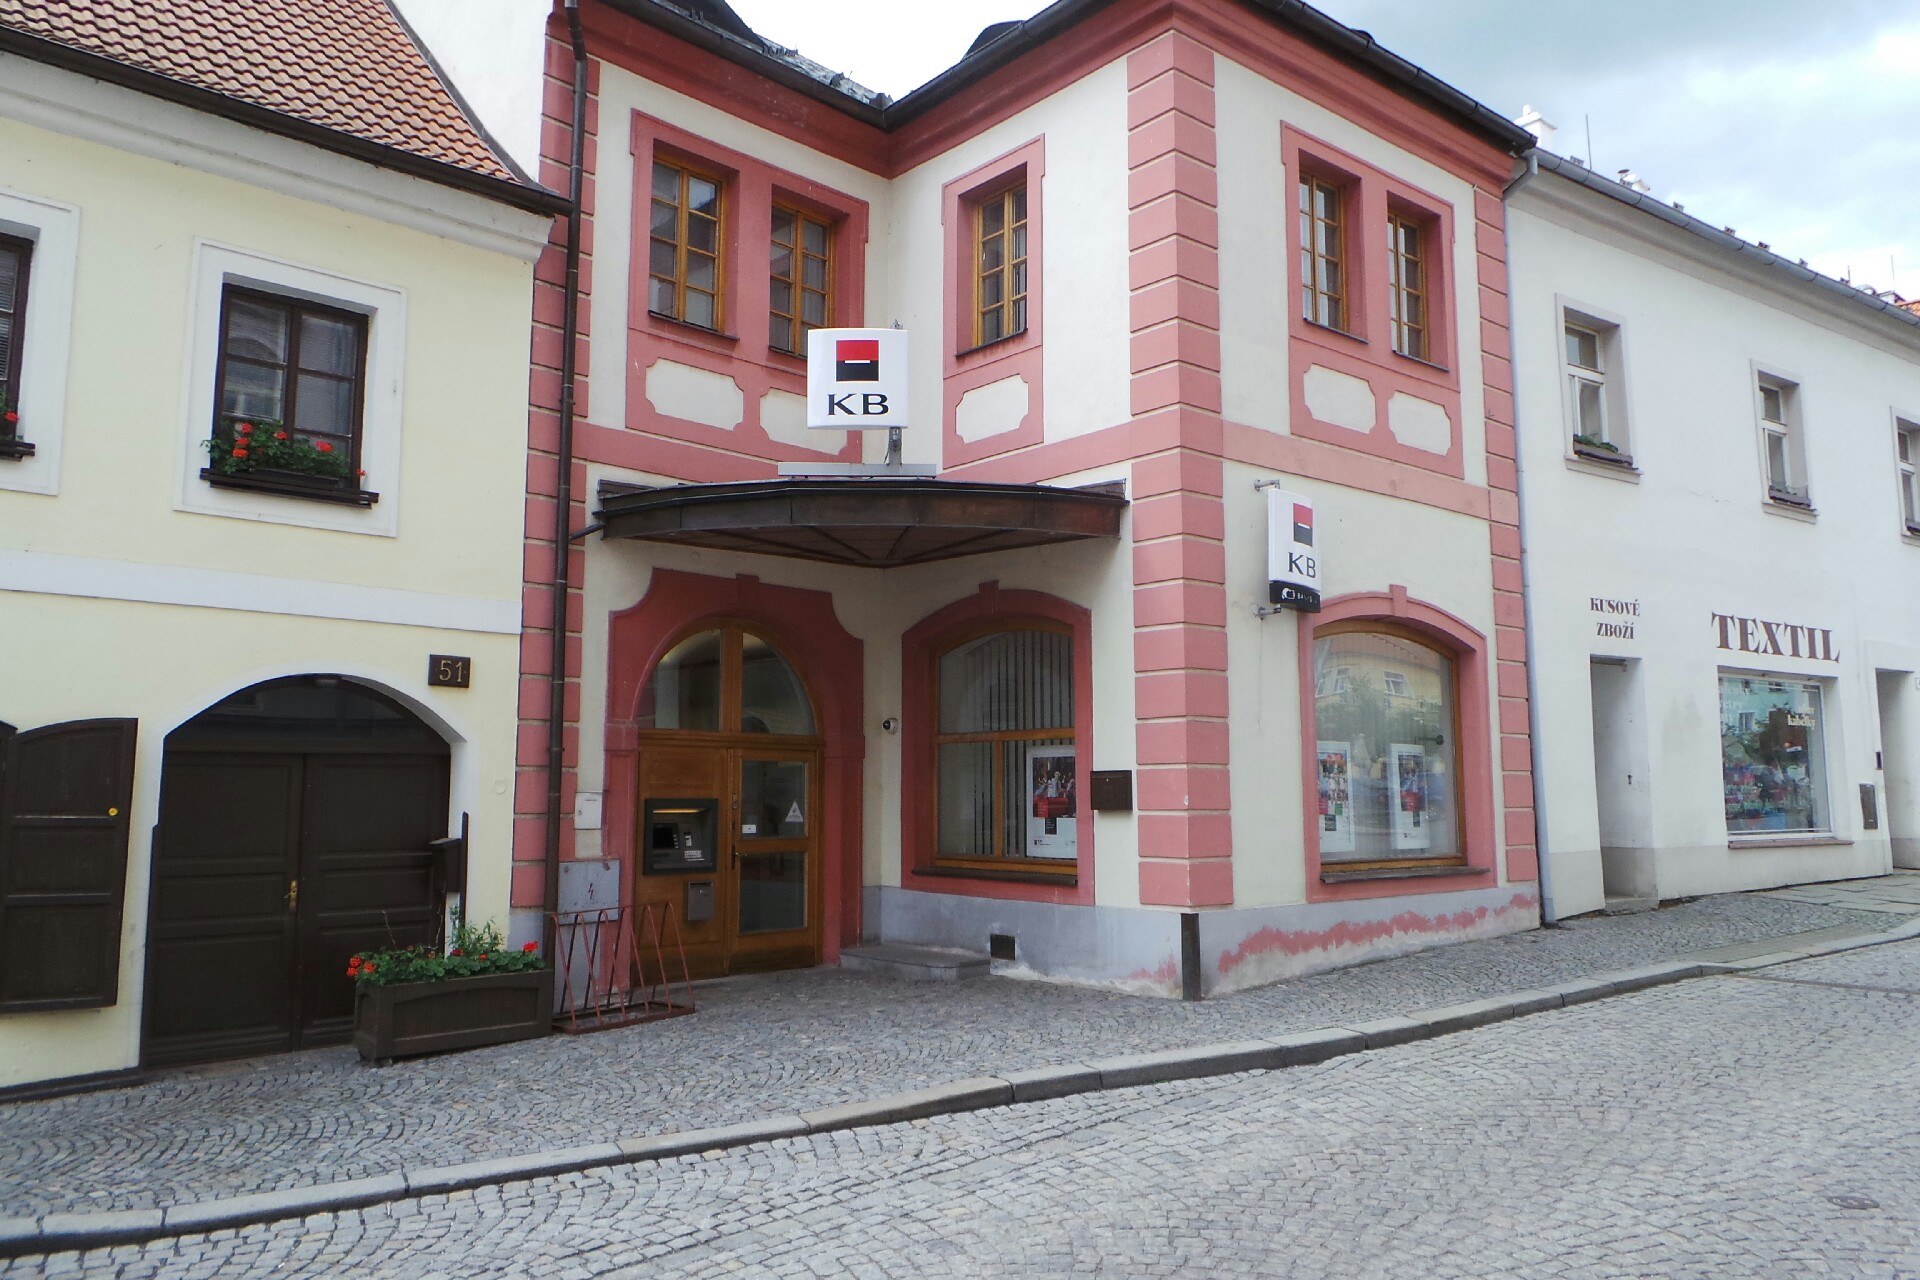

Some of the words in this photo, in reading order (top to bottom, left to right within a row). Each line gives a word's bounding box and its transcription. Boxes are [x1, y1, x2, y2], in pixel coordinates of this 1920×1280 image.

[827, 393, 889, 416] KB
[1288, 552, 1316, 578] KB
[1590, 597, 1640, 617] KUSOVÉ
[1596, 620, 1635, 640] ZBOŽÍ
[1711, 611, 1841, 664] TEXTIL
[439, 659, 463, 682] 51
